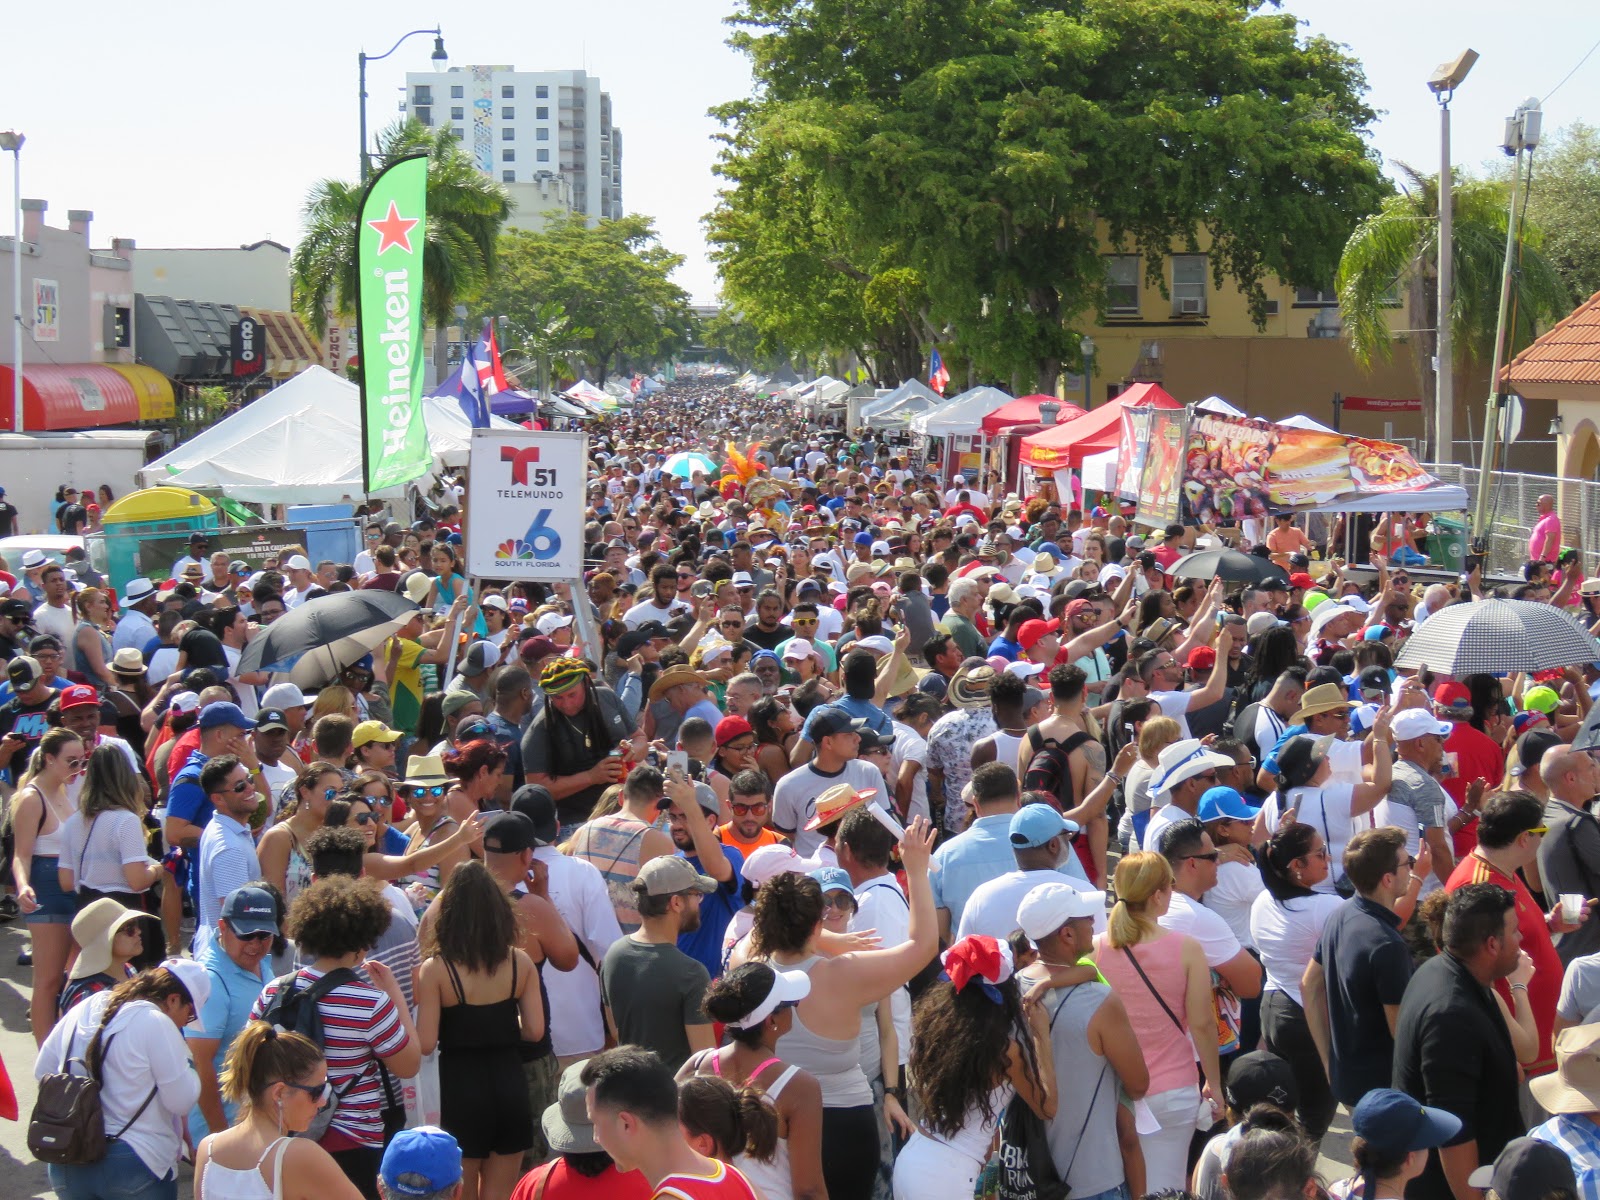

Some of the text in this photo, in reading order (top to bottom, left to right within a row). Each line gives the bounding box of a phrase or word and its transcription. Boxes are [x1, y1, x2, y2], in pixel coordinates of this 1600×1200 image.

[241, 321, 254, 361] OCHO
[380, 268, 412, 458] Heineken
[1222, 423, 1270, 446] KEBABS
[534, 468, 557, 486] 51
[497, 489, 564, 500] TELEMUNDO
[523, 508, 562, 560] 6
[262, 545, 271, 553] LA
[525, 560, 561, 568] FLORIDA
